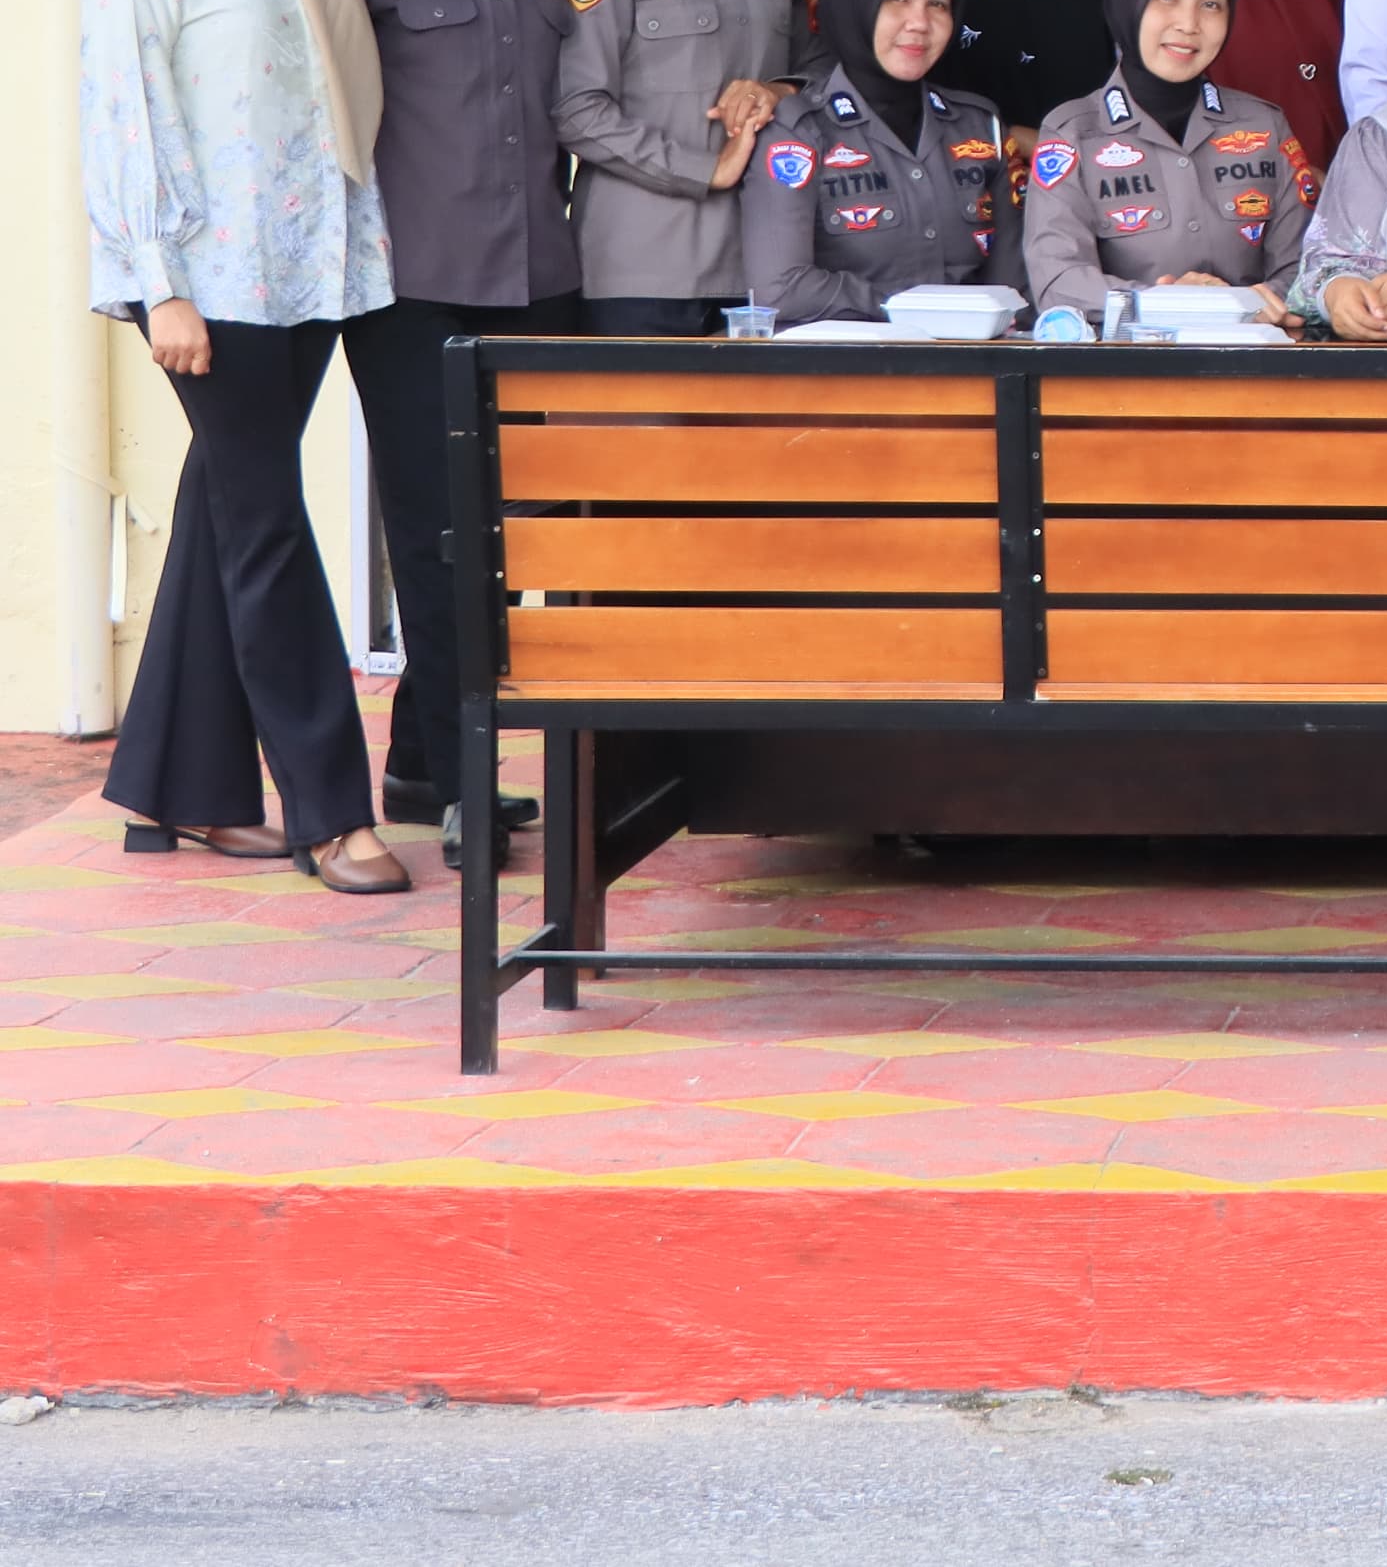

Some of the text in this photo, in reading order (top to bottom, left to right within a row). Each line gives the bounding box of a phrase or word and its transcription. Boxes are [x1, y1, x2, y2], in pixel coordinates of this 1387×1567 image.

[1215, 160, 1276, 183] POLRI
[823, 172, 888, 197] TITIN
[1099, 173, 1156, 199] AMEL
